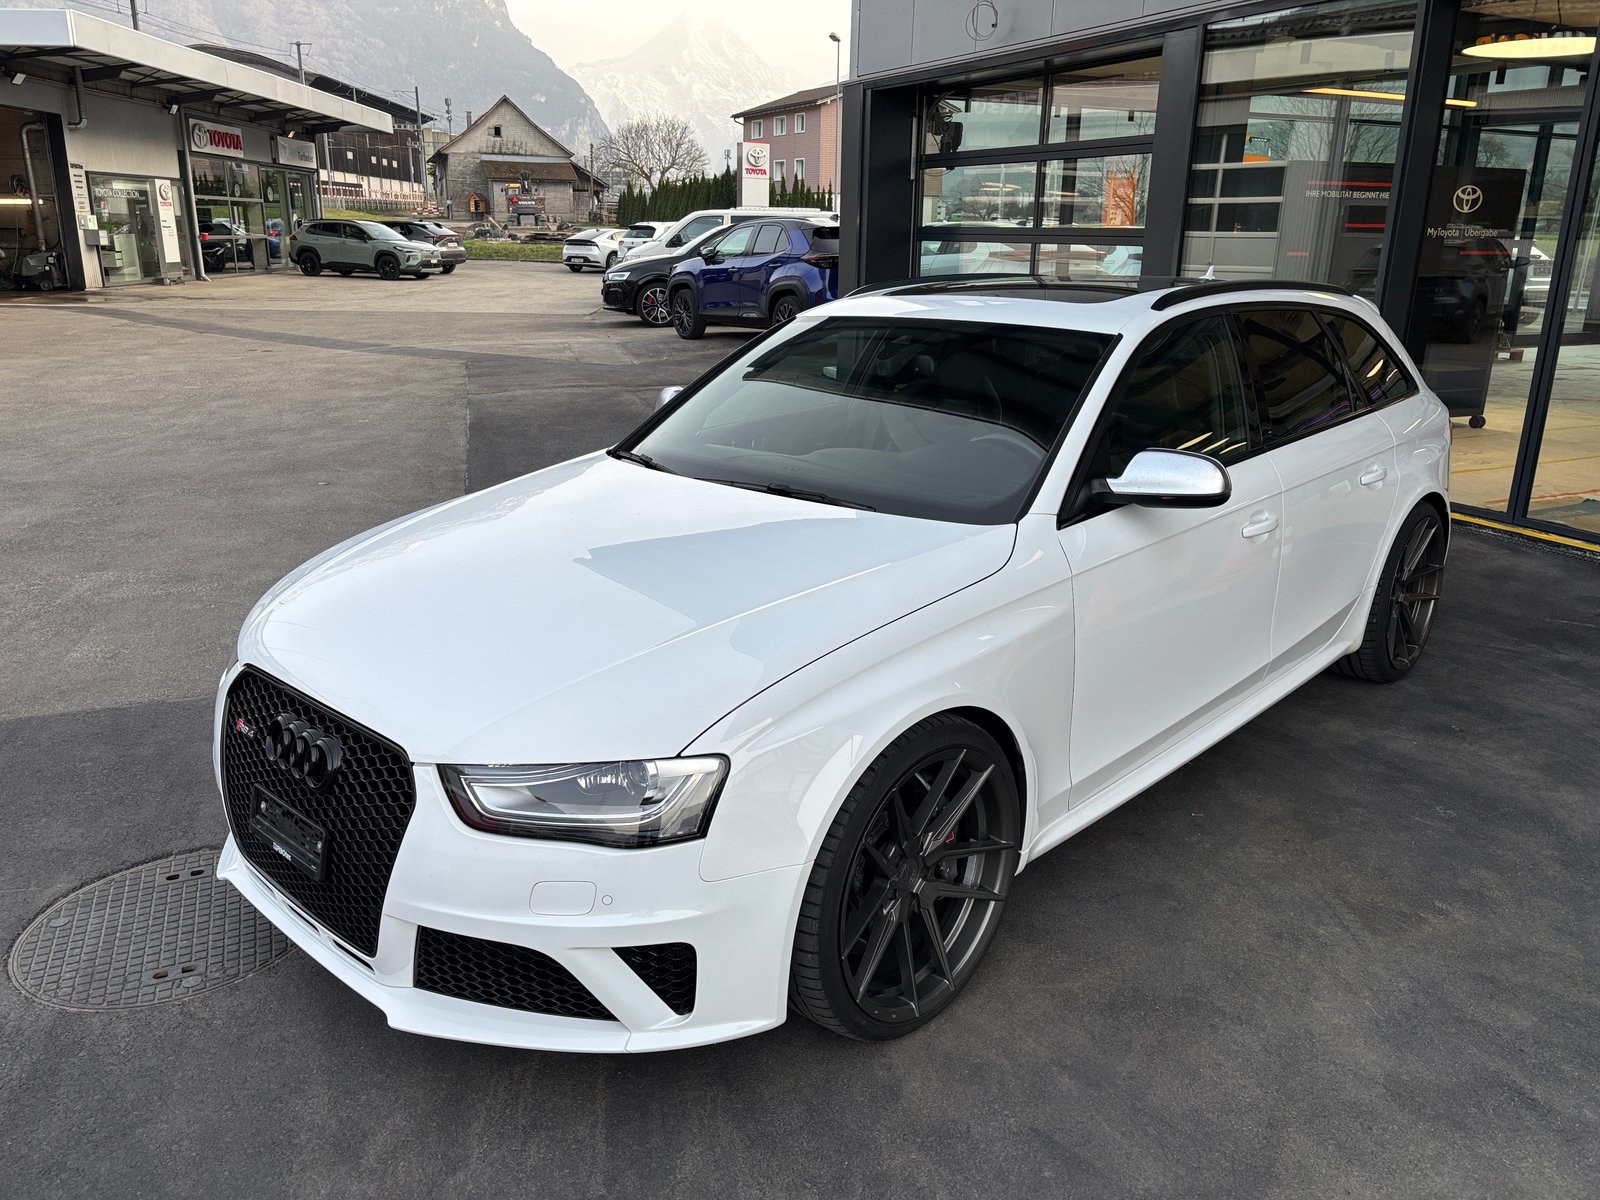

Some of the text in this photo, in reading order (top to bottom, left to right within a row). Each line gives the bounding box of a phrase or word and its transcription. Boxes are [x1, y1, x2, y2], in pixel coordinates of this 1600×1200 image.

[207, 129, 243, 151] TOYOTA
[745, 168, 767, 176] TOYOTA
[94, 187, 140, 199] TOYOTA COLLECTION
[1305, 189, 1391, 199] IHRE MOBILITÄT BEGINNT HIE
[1427, 227, 1459, 238] MyToyota
